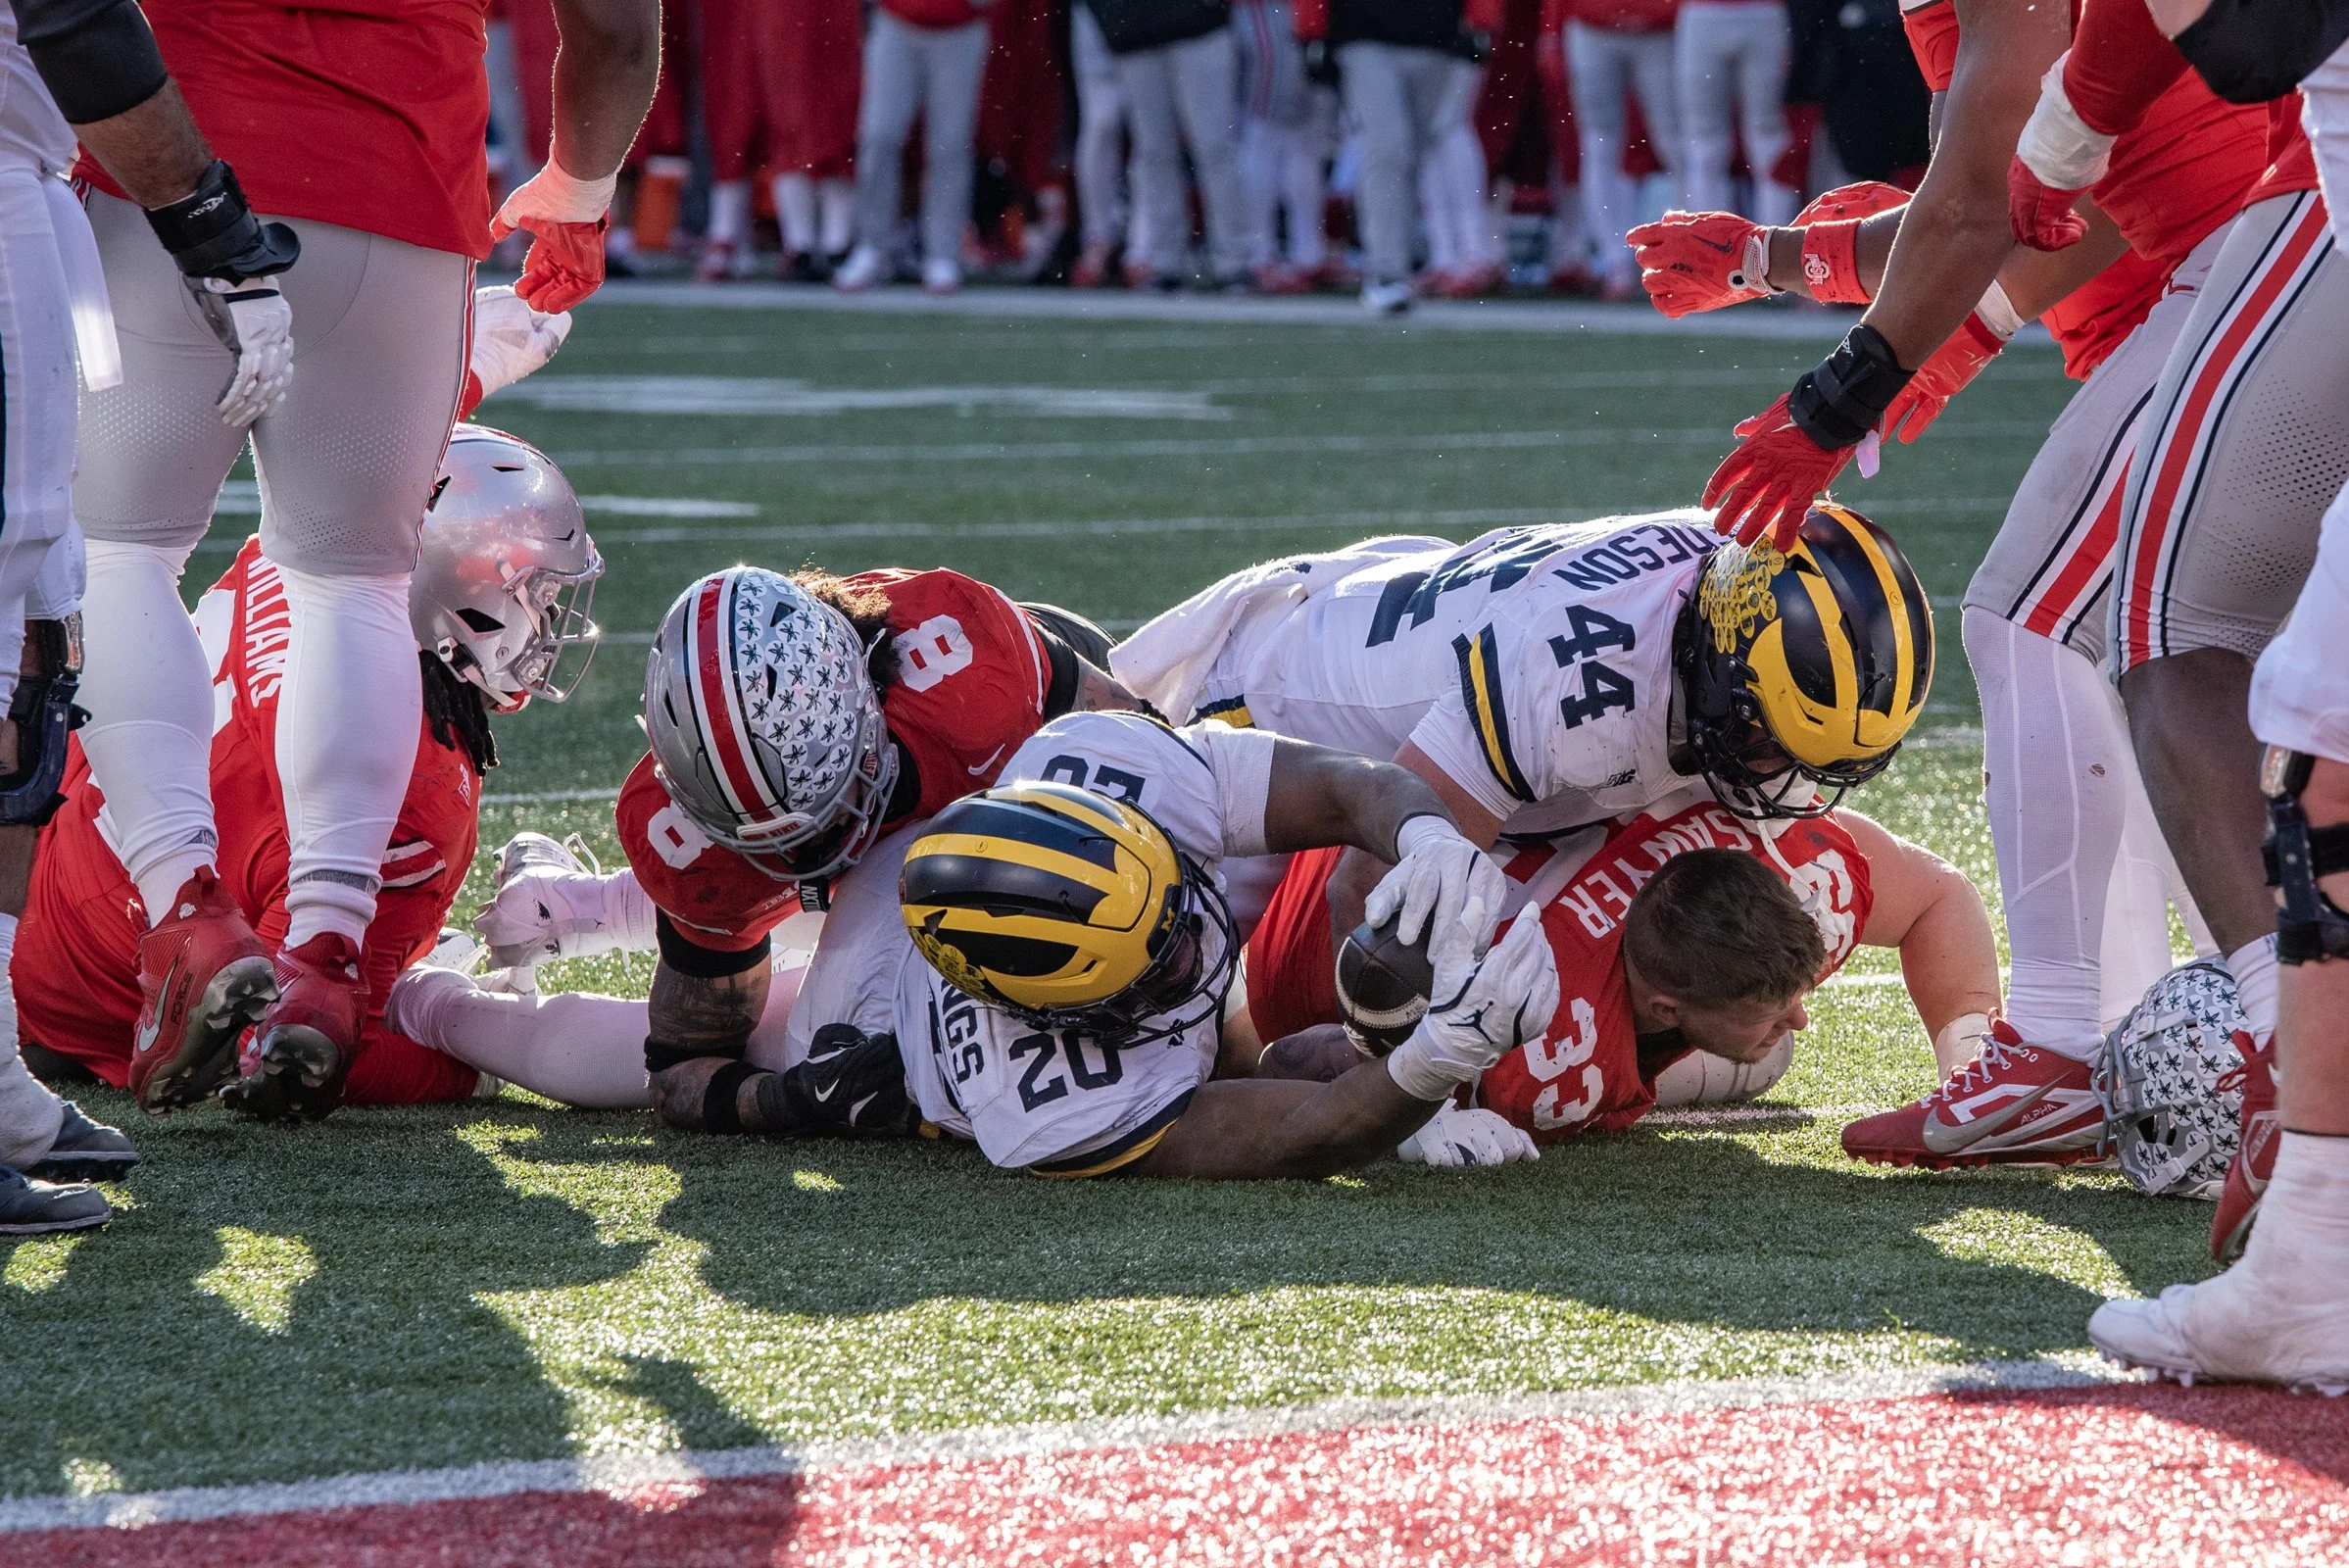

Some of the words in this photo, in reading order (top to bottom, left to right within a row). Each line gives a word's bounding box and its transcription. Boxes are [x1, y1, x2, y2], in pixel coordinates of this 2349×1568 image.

[1552, 523, 1729, 591] DESON
[894, 613, 973, 693] 8
[1547, 604, 1636, 730] 44
[1007, 1028, 1124, 1114] 20
[1525, 997, 1604, 1131] 33
[2020, 1102, 2058, 1126] ALPHA
